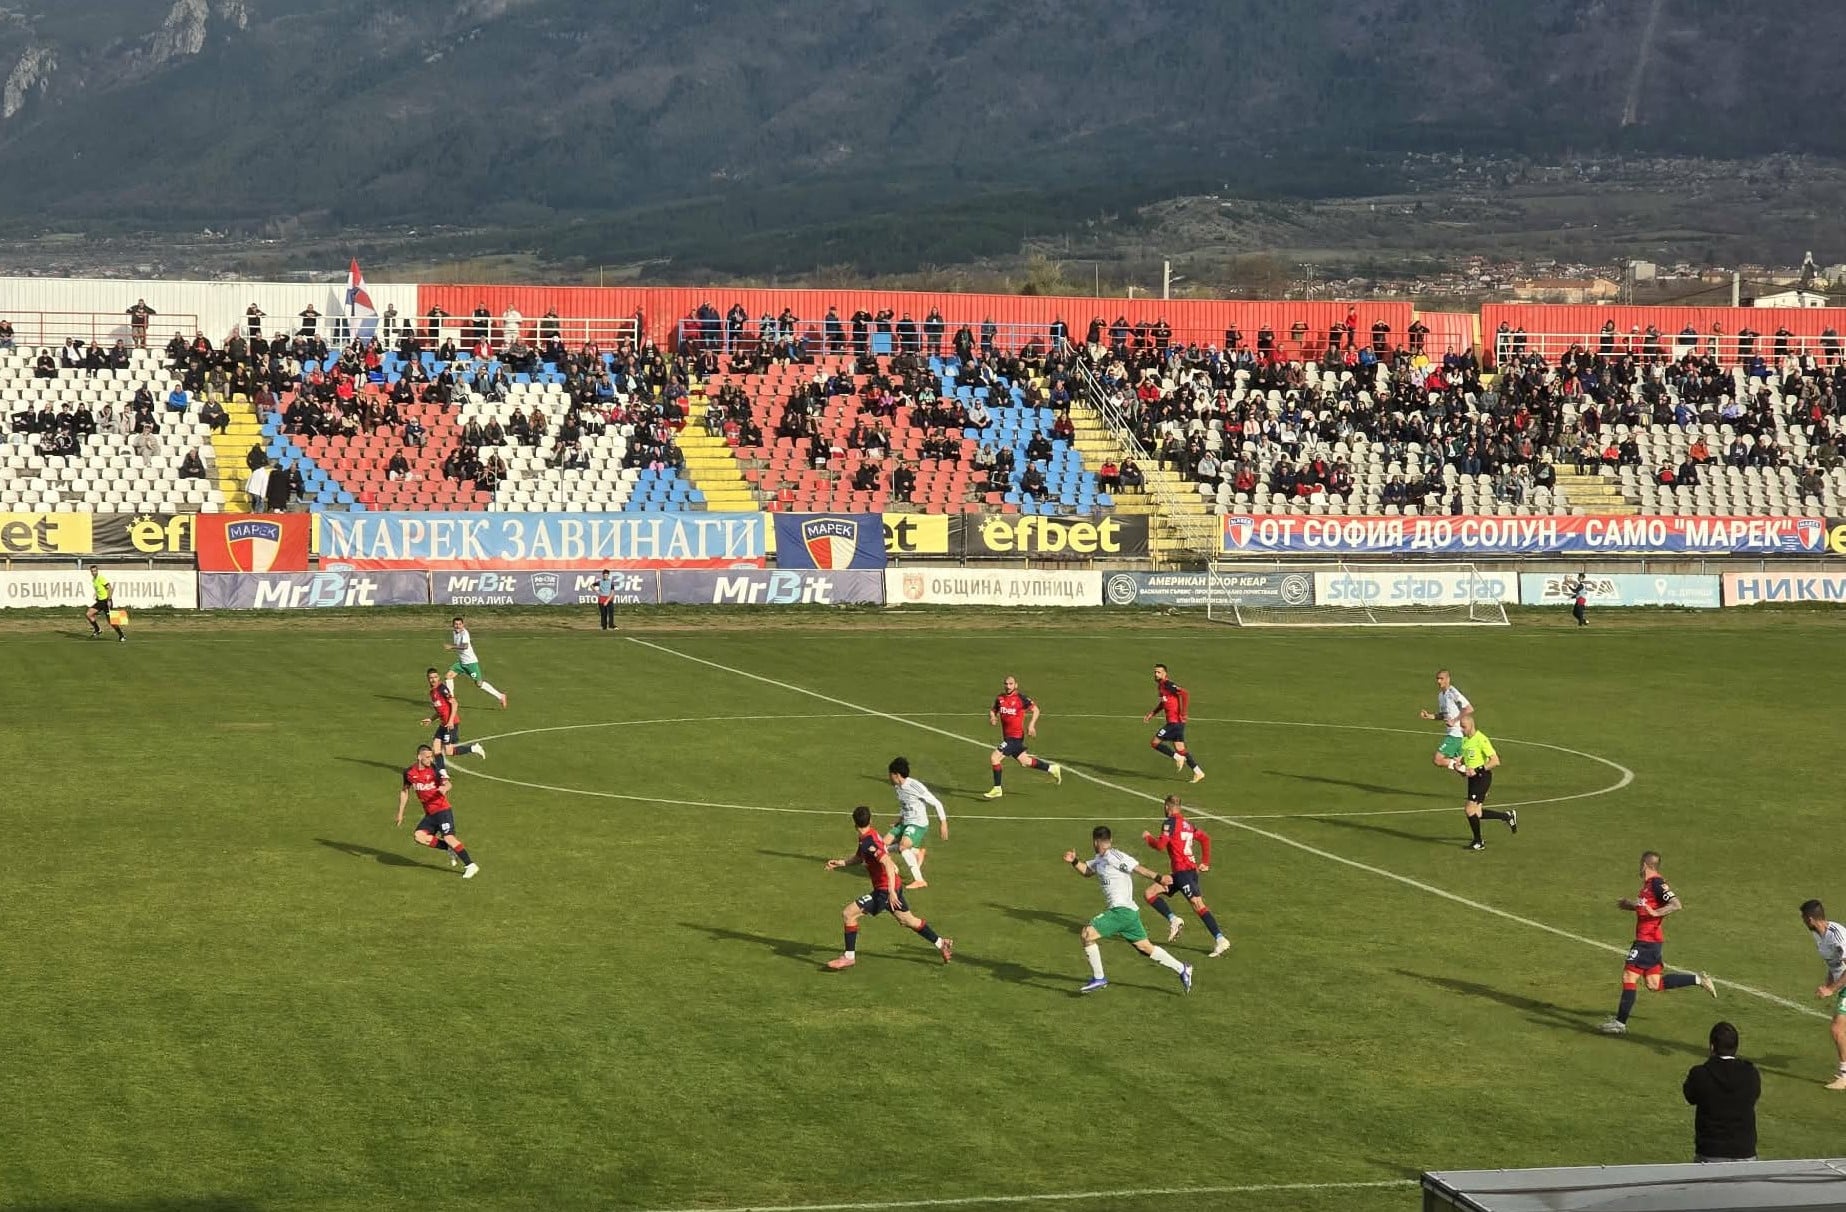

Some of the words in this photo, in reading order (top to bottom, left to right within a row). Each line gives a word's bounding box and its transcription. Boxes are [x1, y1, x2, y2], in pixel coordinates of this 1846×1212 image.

[327, 518, 491, 560] МАРЕК
[501, 518, 759, 561] ЗАВИНАГИ
[807, 523, 852, 537] МАРЕК
[982, 515, 1120, 552] efbet
[1259, 518, 1297, 546] ОТ
[1303, 518, 1404, 547] СОФИЯ
[1411, 519, 1452, 549] ДО
[1461, 519, 1557, 547] СОЛУН
[1585, 519, 1667, 547] САМО
[1674, 518, 1793, 547] "МАРЕК"
[7, 582, 86, 600] ОБЩИНА
[111, 581, 177, 599] УПНИЦА
[253, 572, 378, 608] MrBit
[447, 573, 517, 592] MrBit
[574, 572, 644, 592] MBit
[712, 571, 833, 605] MrBit
[932, 578, 1002, 596] ОБЩИНА
[1008, 579, 1085, 599] ДУПНИЦА
[1148, 576, 1206, 586] АМЕРИКАН
[1239, 577, 1267, 586] КЕАР
[451, 596, 483, 605] ВТОРА
[486, 596, 514, 605] ЛИГА
